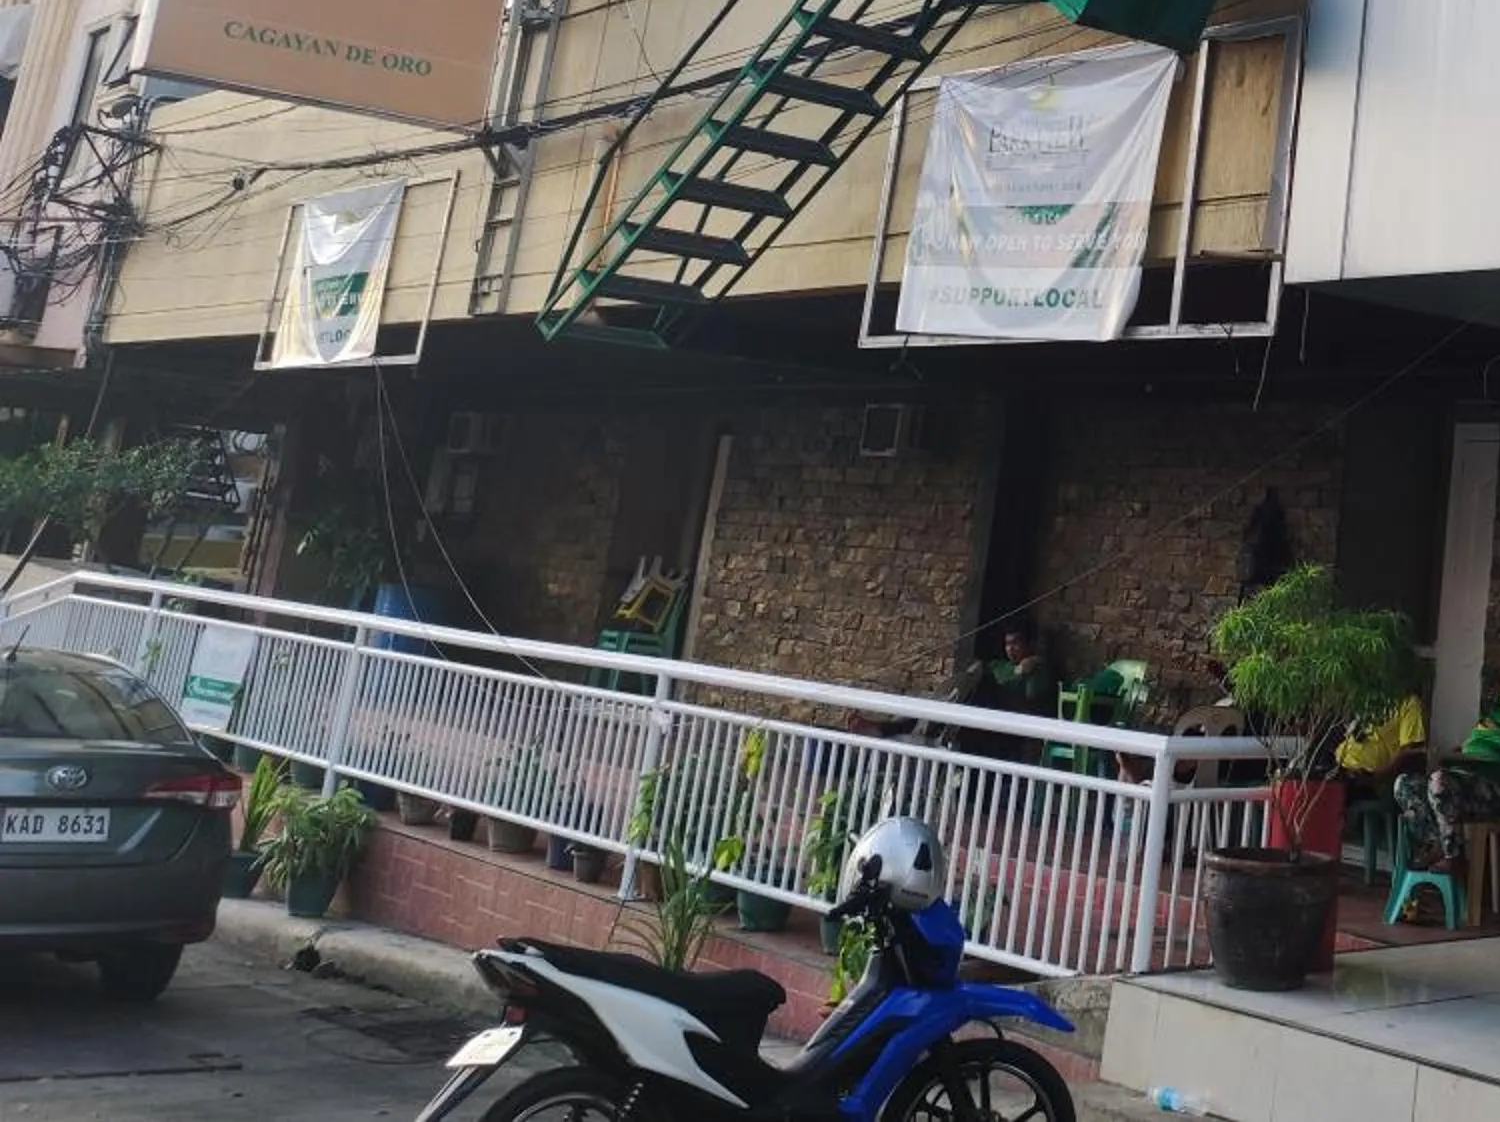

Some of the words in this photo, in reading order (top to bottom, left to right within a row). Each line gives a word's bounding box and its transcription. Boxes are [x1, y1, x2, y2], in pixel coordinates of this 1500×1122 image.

[223, 20, 340, 57] CAGAYAN
[345, 44, 376, 65] DE
[382, 52, 433, 76] ORO
[5, 814, 44, 834] KAD
[57, 814, 105, 834] 8631
